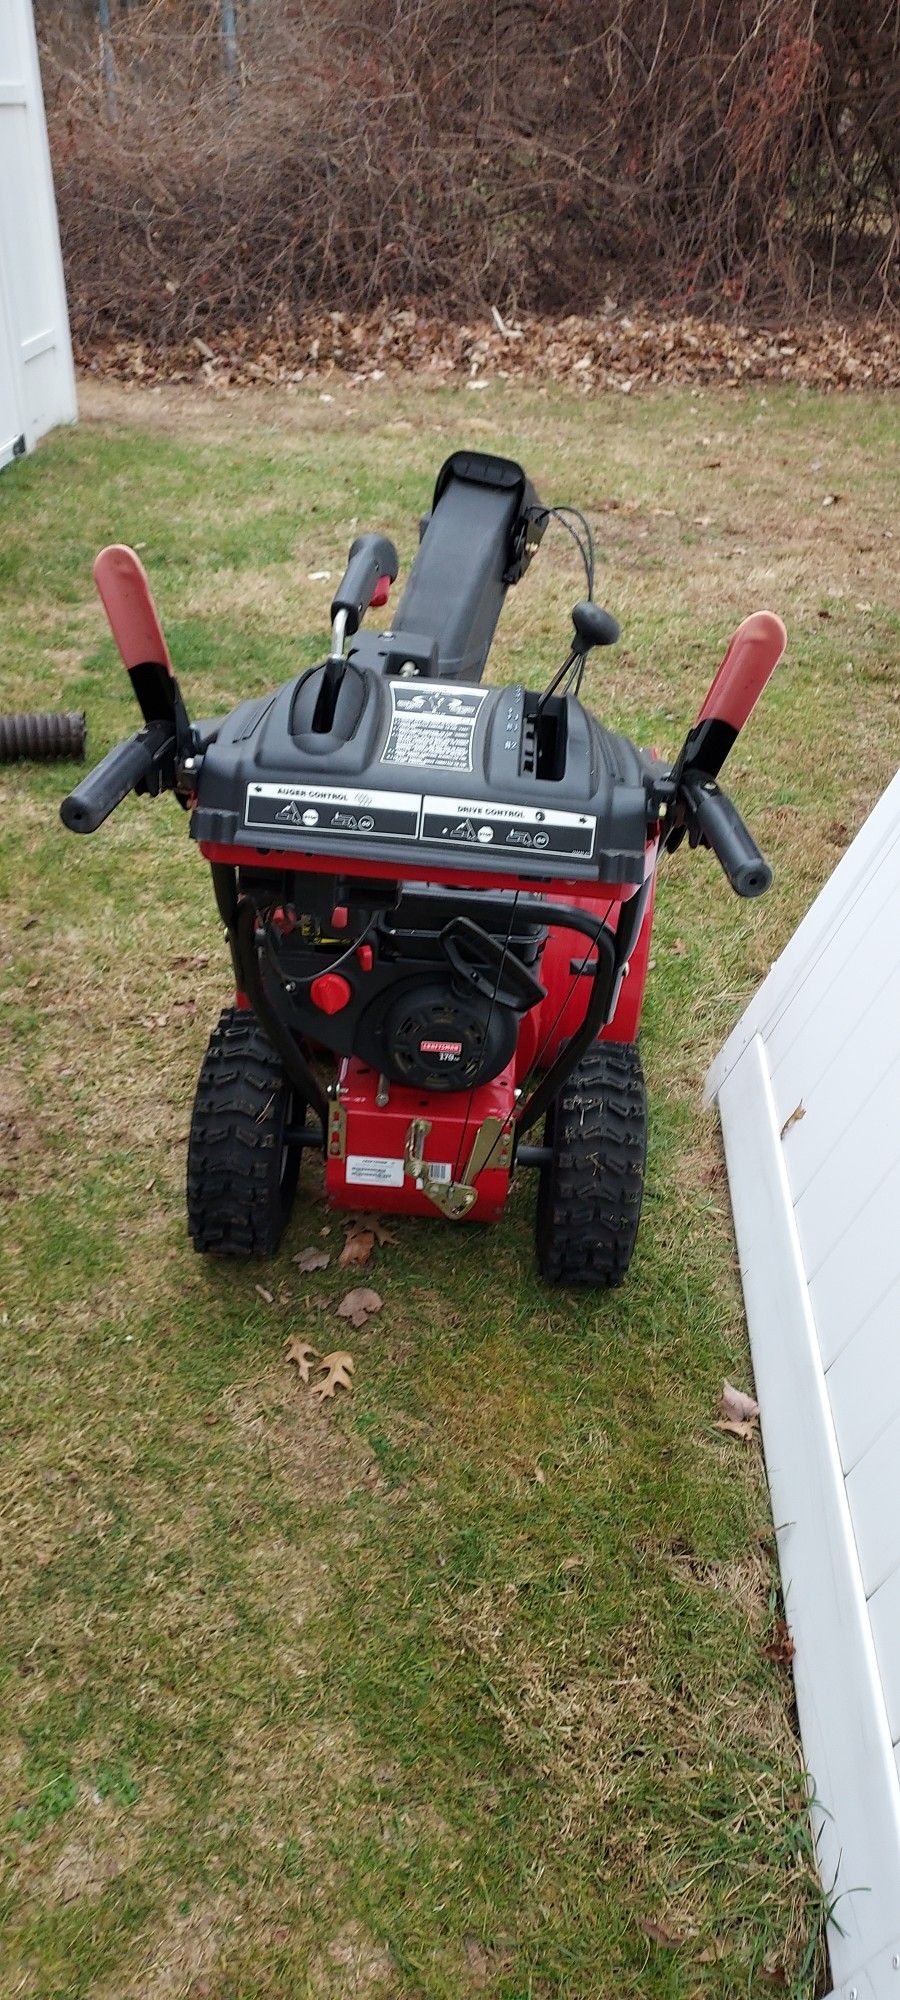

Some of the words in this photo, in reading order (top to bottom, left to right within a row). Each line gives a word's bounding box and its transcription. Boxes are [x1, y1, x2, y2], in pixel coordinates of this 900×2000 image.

[277, 787, 306, 797] AUGER
[308, 790, 348, 801] CONTROL
[457, 805, 483, 814] DRIVE
[485, 807, 525, 818] CONTROL
[422, 1042, 460, 1051] CRAFTSMAN
